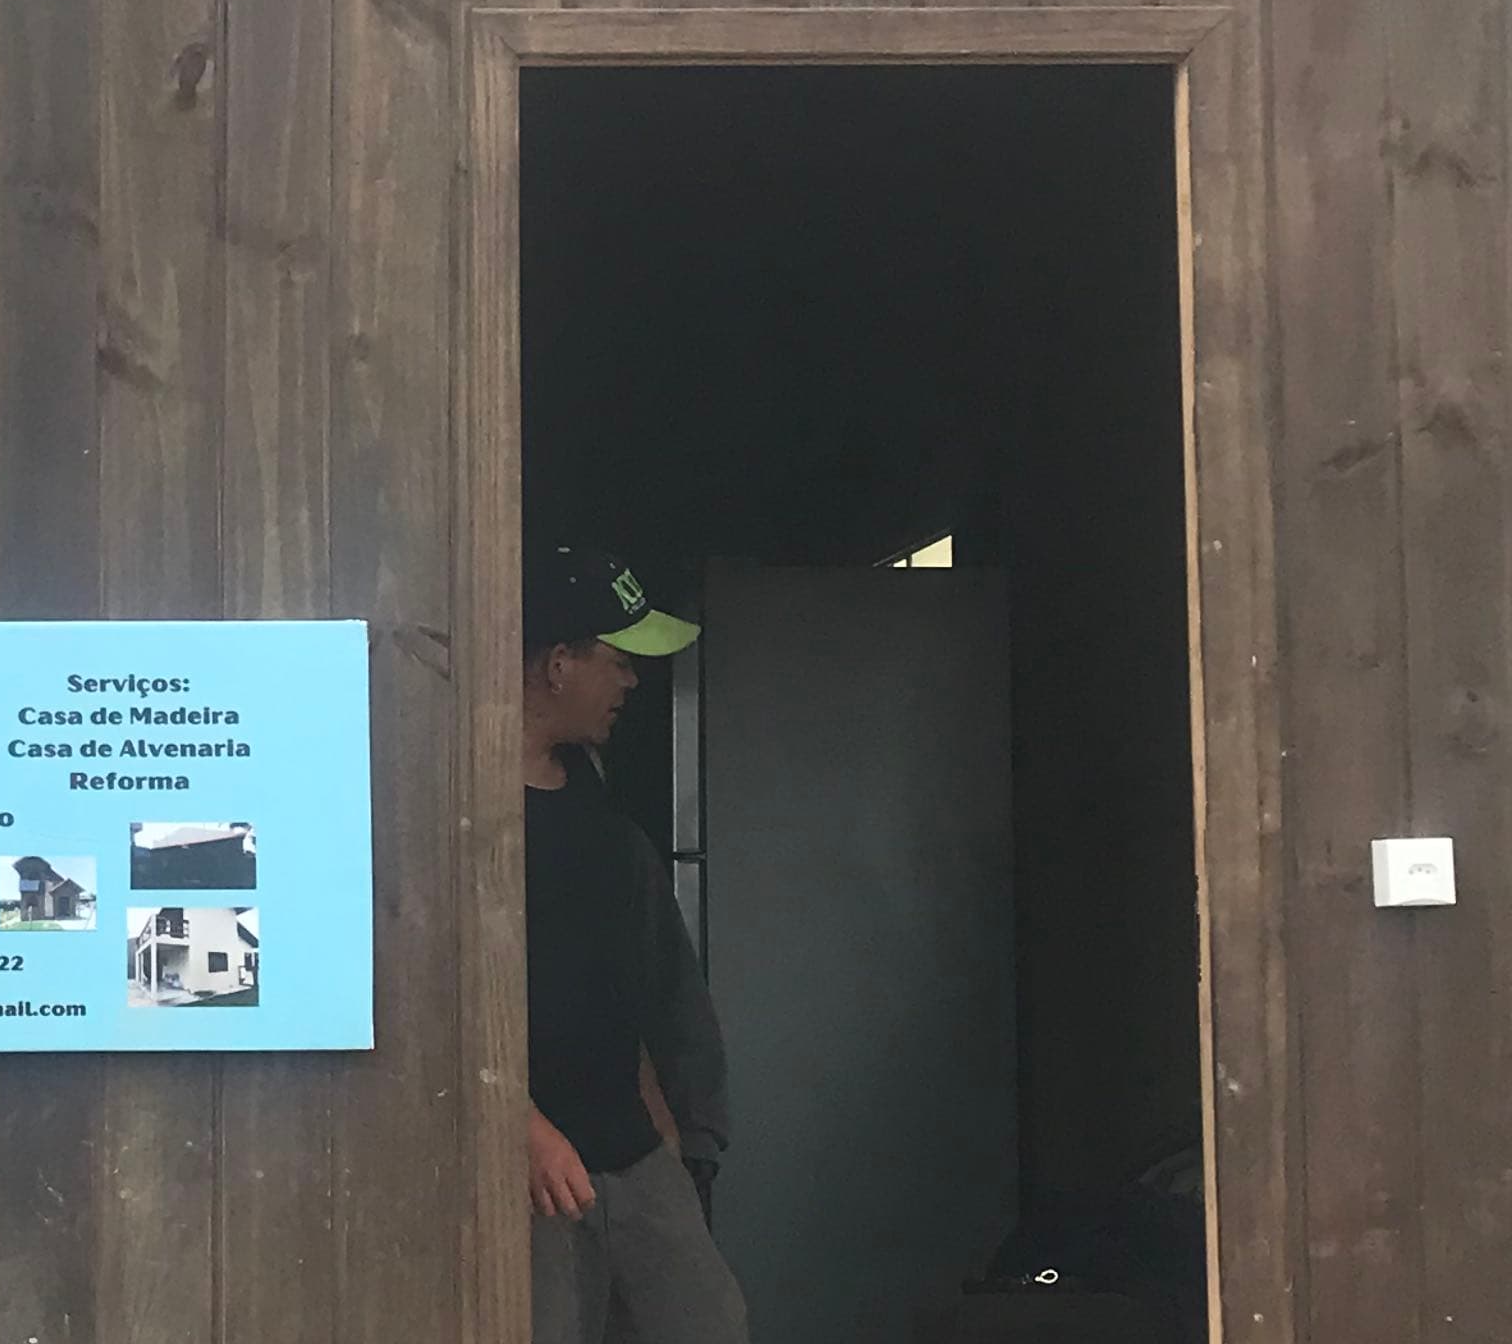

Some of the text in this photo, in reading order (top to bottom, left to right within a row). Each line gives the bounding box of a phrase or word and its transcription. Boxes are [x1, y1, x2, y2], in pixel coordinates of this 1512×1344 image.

[67, 673, 191, 699] Serviços:
[17, 706, 240, 726] Casa de Madeira
[7, 738, 251, 758] Casa de Alvenaria
[69, 771, 190, 791] Reforma
